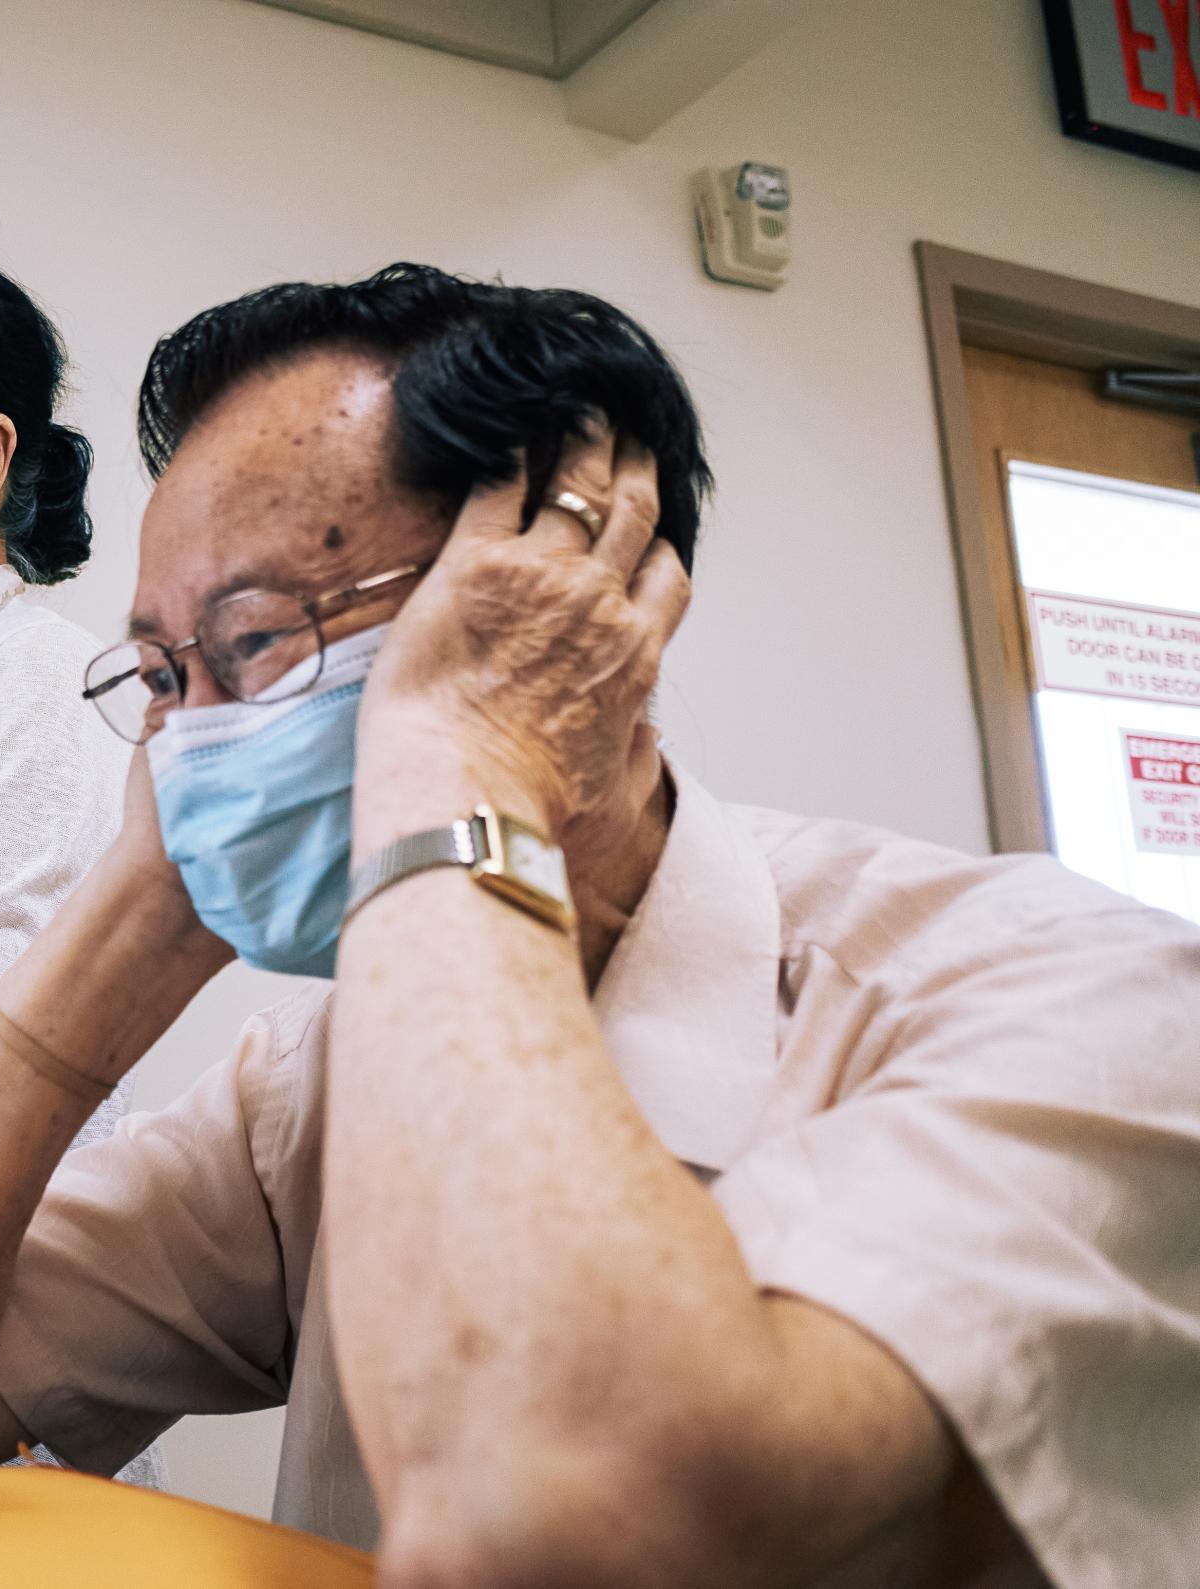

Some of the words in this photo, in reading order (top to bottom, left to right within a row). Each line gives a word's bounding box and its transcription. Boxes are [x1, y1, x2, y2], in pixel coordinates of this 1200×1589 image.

[1040, 608, 1088, 628] PUSH
[1093, 615, 1140, 637] UNTIL
[1067, 638, 1119, 659] DOOR
[1125, 646, 1161, 664] CAN
[1166, 652, 1186, 670] BE
[1128, 674, 1146, 690] 15
